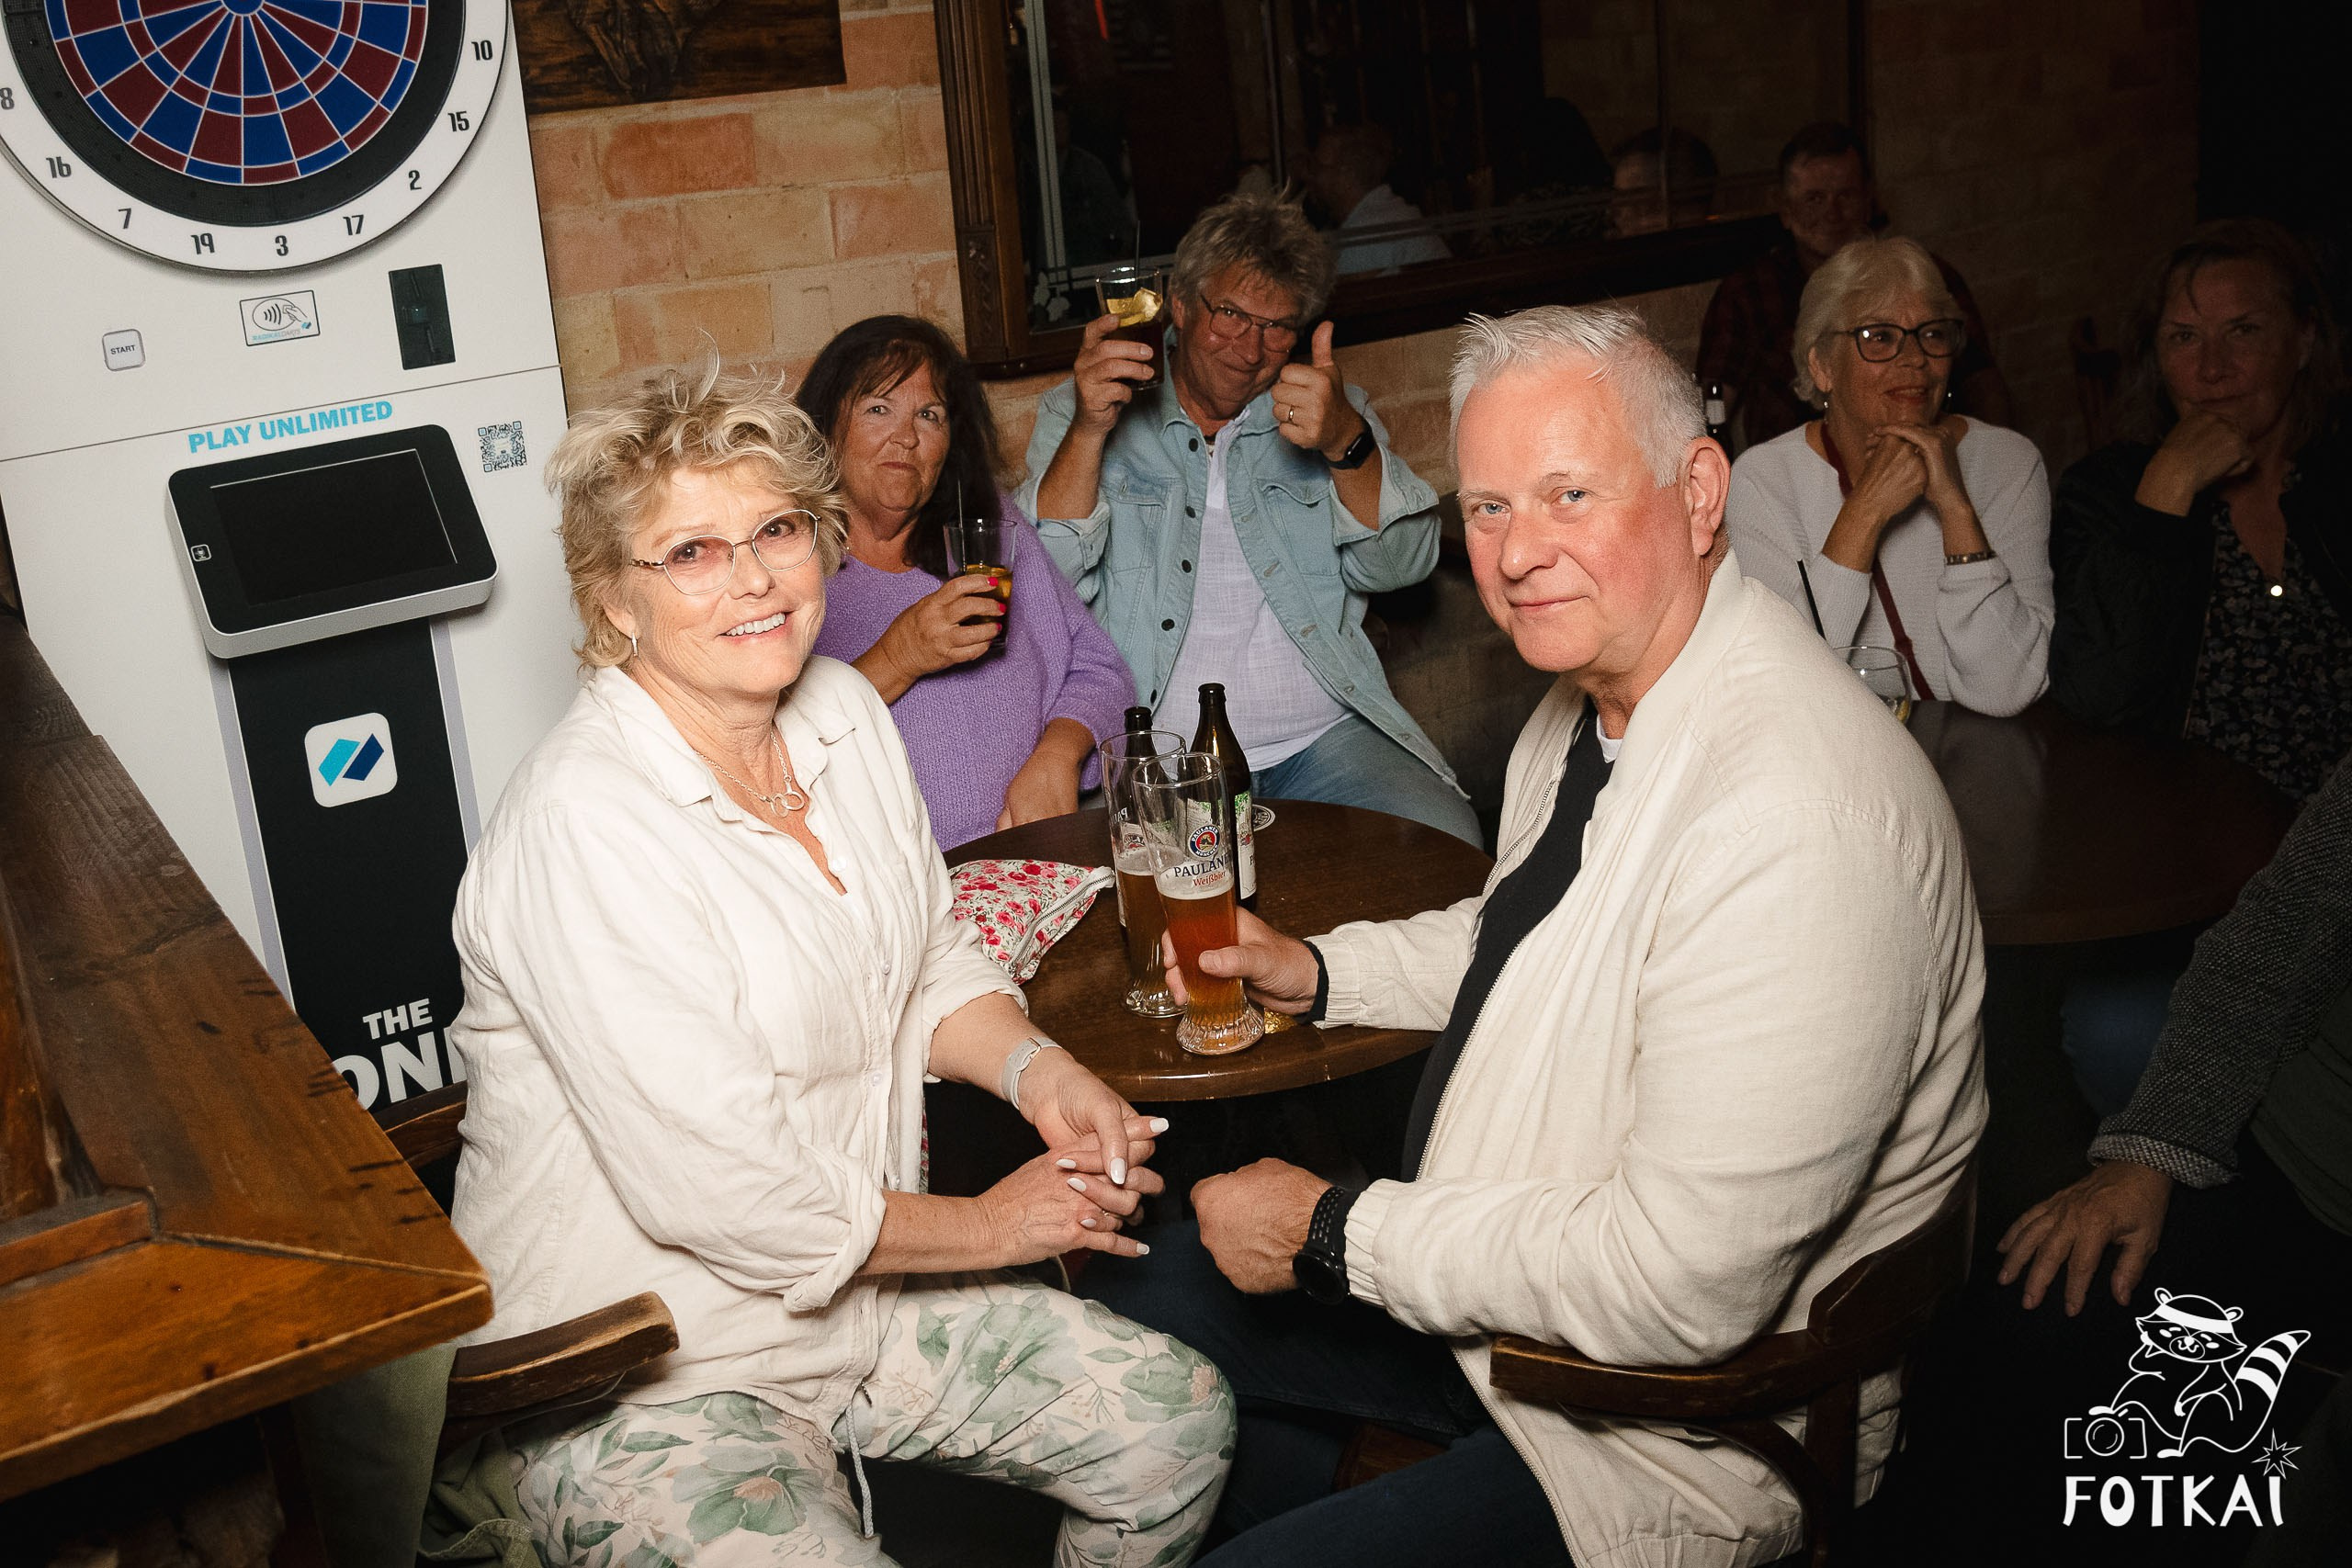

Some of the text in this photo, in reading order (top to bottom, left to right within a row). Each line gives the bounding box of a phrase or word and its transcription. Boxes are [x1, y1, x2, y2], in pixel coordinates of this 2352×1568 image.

[471, 40, 493, 61] 10
[448, 110, 469, 131] 15
[46, 156, 72, 178] 16
[409, 170, 422, 190] 2
[119, 209, 131, 229] 7
[343, 215, 364, 235] 17
[191, 232, 215, 254] 19
[275, 235, 288, 256] 3
[110, 344, 136, 355] START
[188, 400, 393, 453] PLAY UNLIMITED
[1193, 870, 1227, 886] Weißbier
[363, 998, 433, 1040] THE
